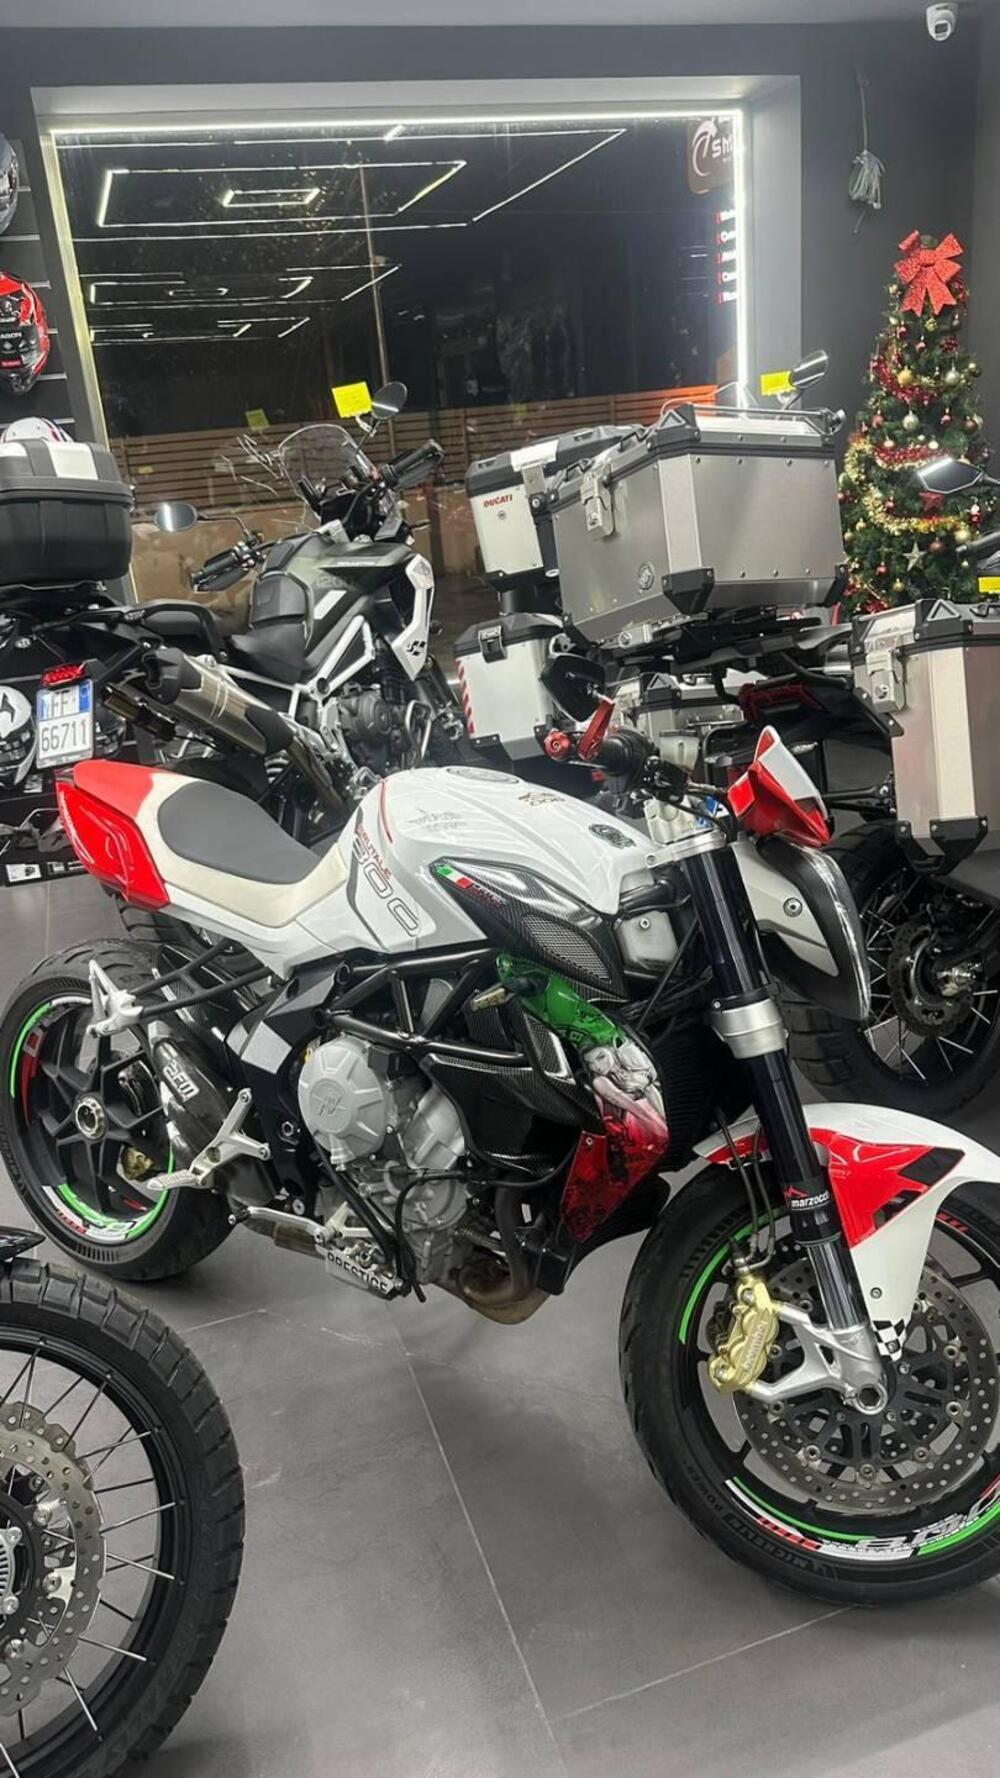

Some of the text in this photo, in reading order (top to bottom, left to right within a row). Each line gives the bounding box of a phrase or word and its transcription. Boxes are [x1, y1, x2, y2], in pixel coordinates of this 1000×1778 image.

[483, 494, 513, 508] DUCATI
[41, 720, 87, 752] 66711
[791, 1190, 829, 1207] marzocch
[326, 1251, 389, 1293] PRESTIGE
[727, 1515, 809, 1569] MICHELIN
